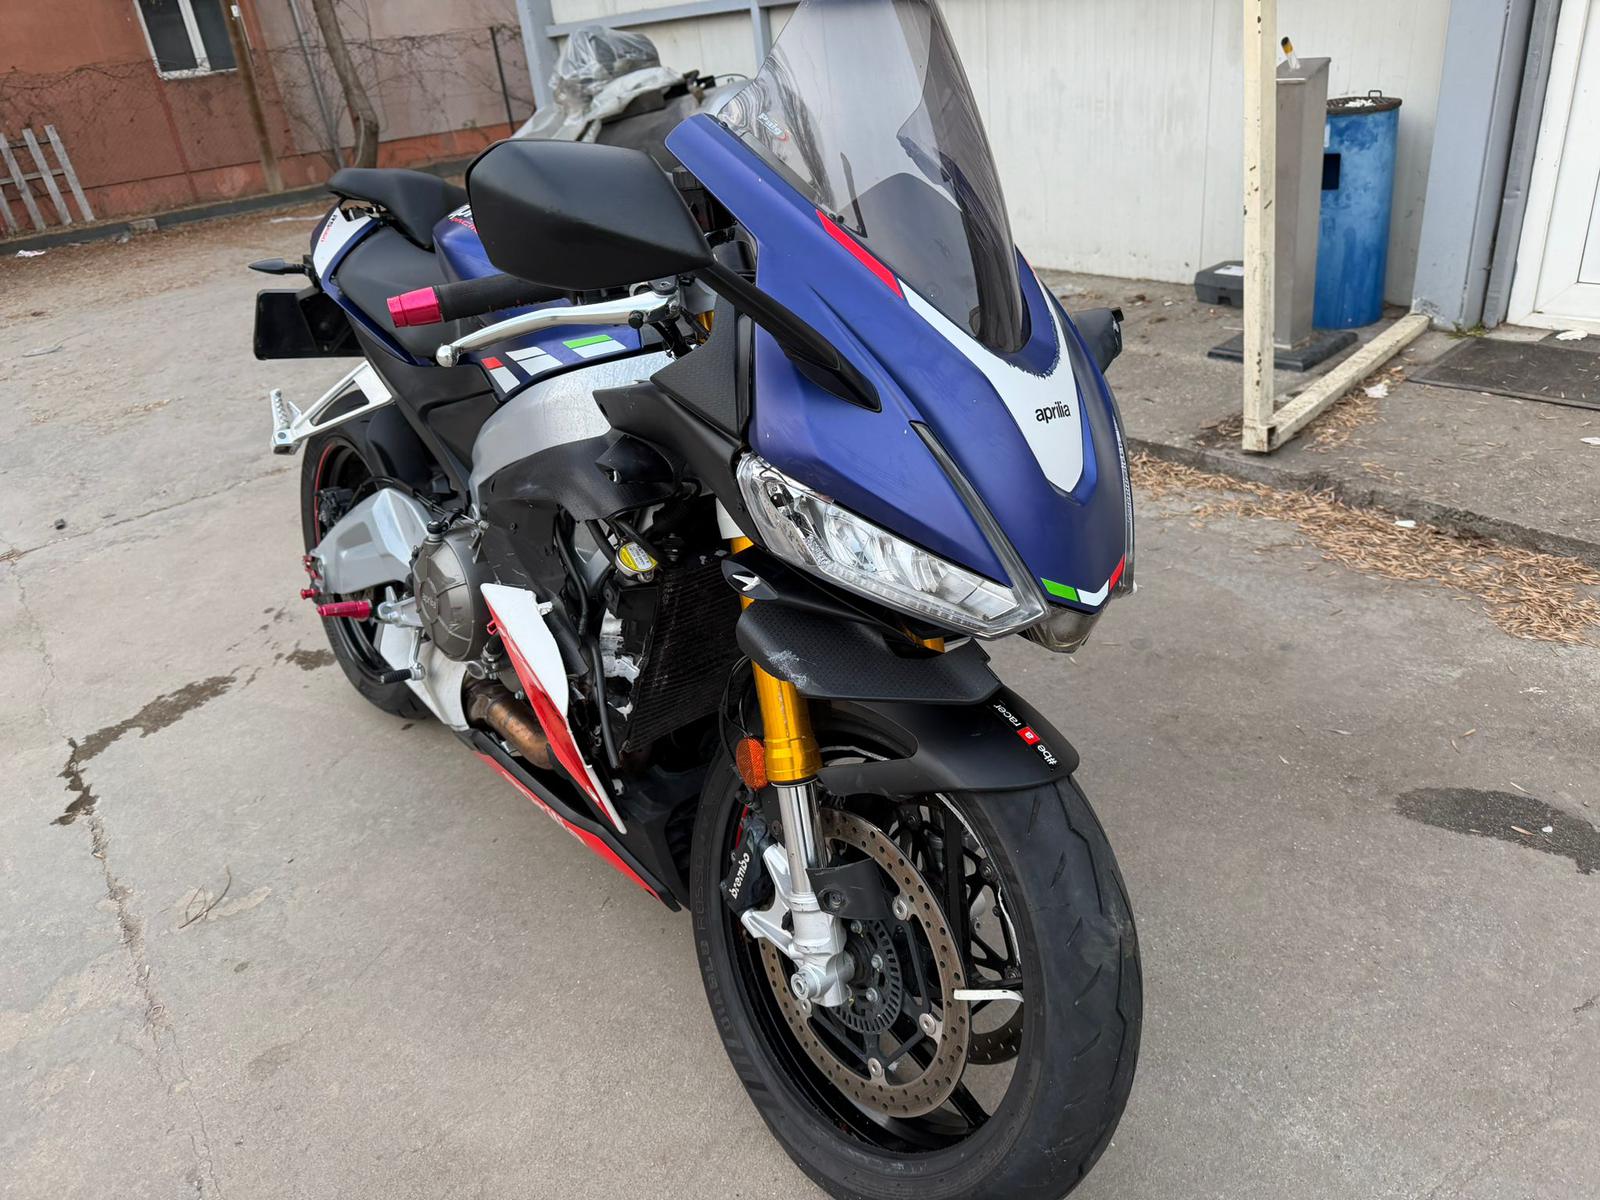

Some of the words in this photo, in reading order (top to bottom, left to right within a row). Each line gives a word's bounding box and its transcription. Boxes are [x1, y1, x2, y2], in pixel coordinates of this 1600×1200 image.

[1035, 401, 1071, 424] aprilia
[993, 704, 1022, 728] racer
[1037, 744, 1058, 765] #be
[728, 852, 750, 900] brembo
[700, 939, 733, 1032] DIABLO
